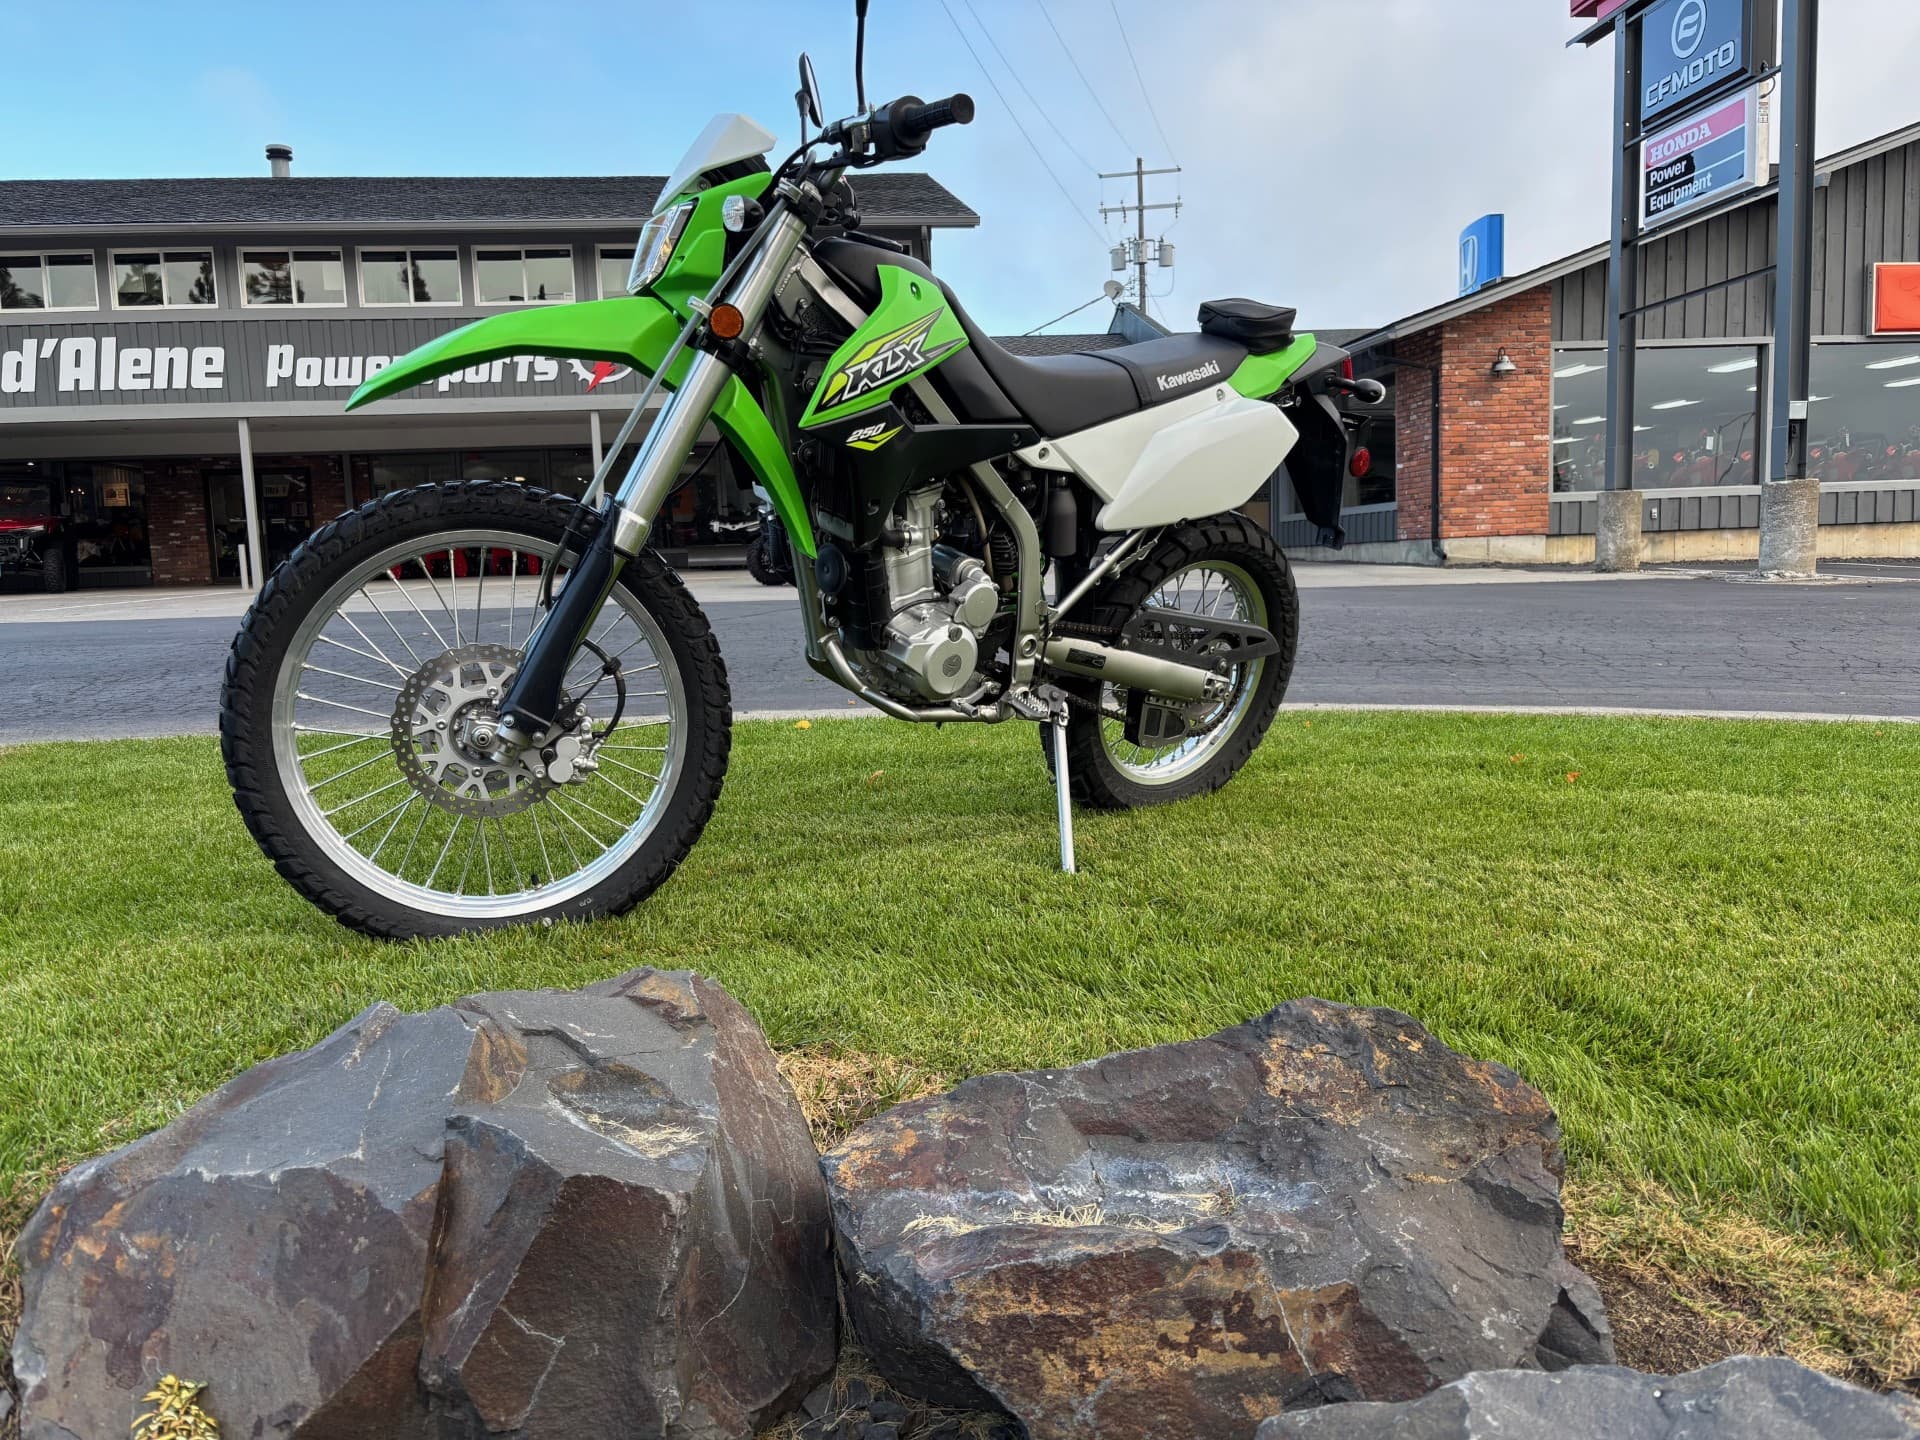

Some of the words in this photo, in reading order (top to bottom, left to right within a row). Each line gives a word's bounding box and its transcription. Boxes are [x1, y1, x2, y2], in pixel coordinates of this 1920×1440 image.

[1646, 40, 1735, 108] CFMOTO
[1650, 122, 1712, 163] HONDA
[1650, 160, 1687, 187] Power
[1650, 171, 1712, 211] Equipment
[1, 337, 225, 392] d'Alene
[266, 344, 559, 392] Poweports
[842, 332, 925, 400] KLX
[1157, 360, 1220, 391] Kawasaki
[846, 422, 887, 442] 250
